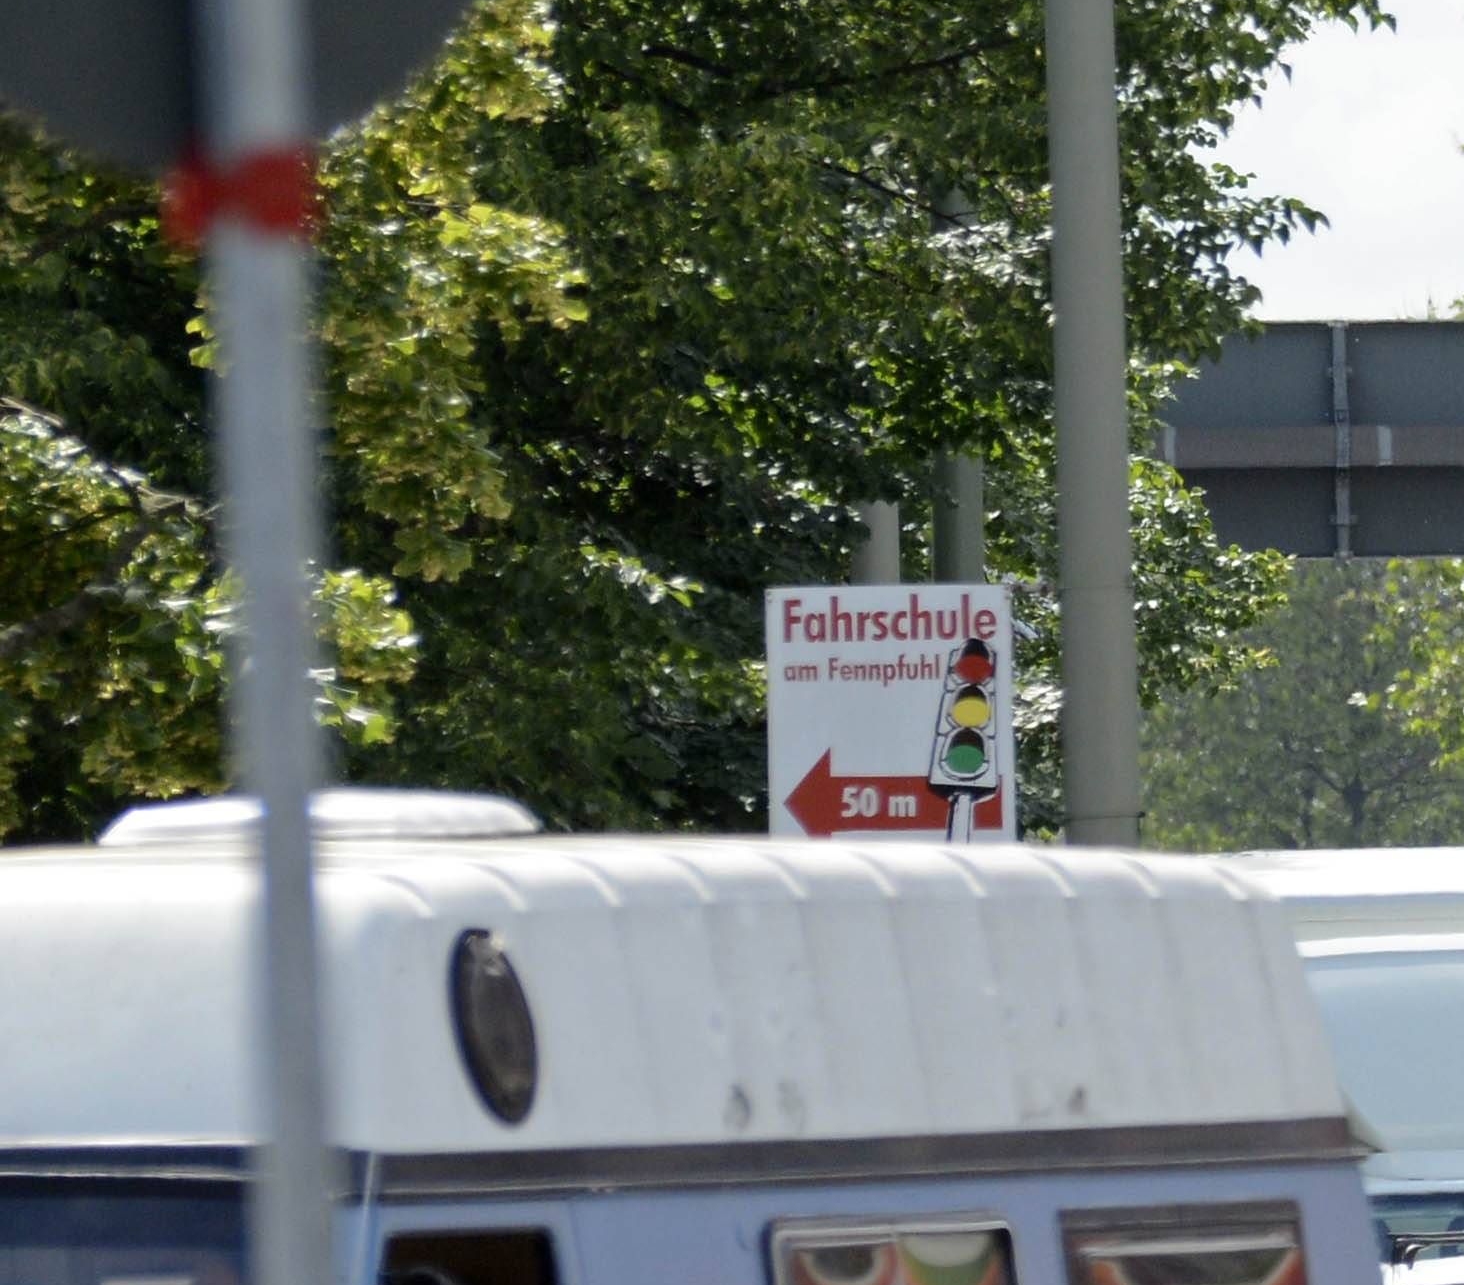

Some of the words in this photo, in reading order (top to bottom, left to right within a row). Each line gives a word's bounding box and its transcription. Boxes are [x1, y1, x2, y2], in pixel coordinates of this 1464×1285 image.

[782, 593, 998, 643] Fahrschule
[783, 664, 818, 683] am
[828, 653, 941, 687] Fennpfuhl
[840, 785, 880, 818] 50
[888, 790, 918, 818] m
